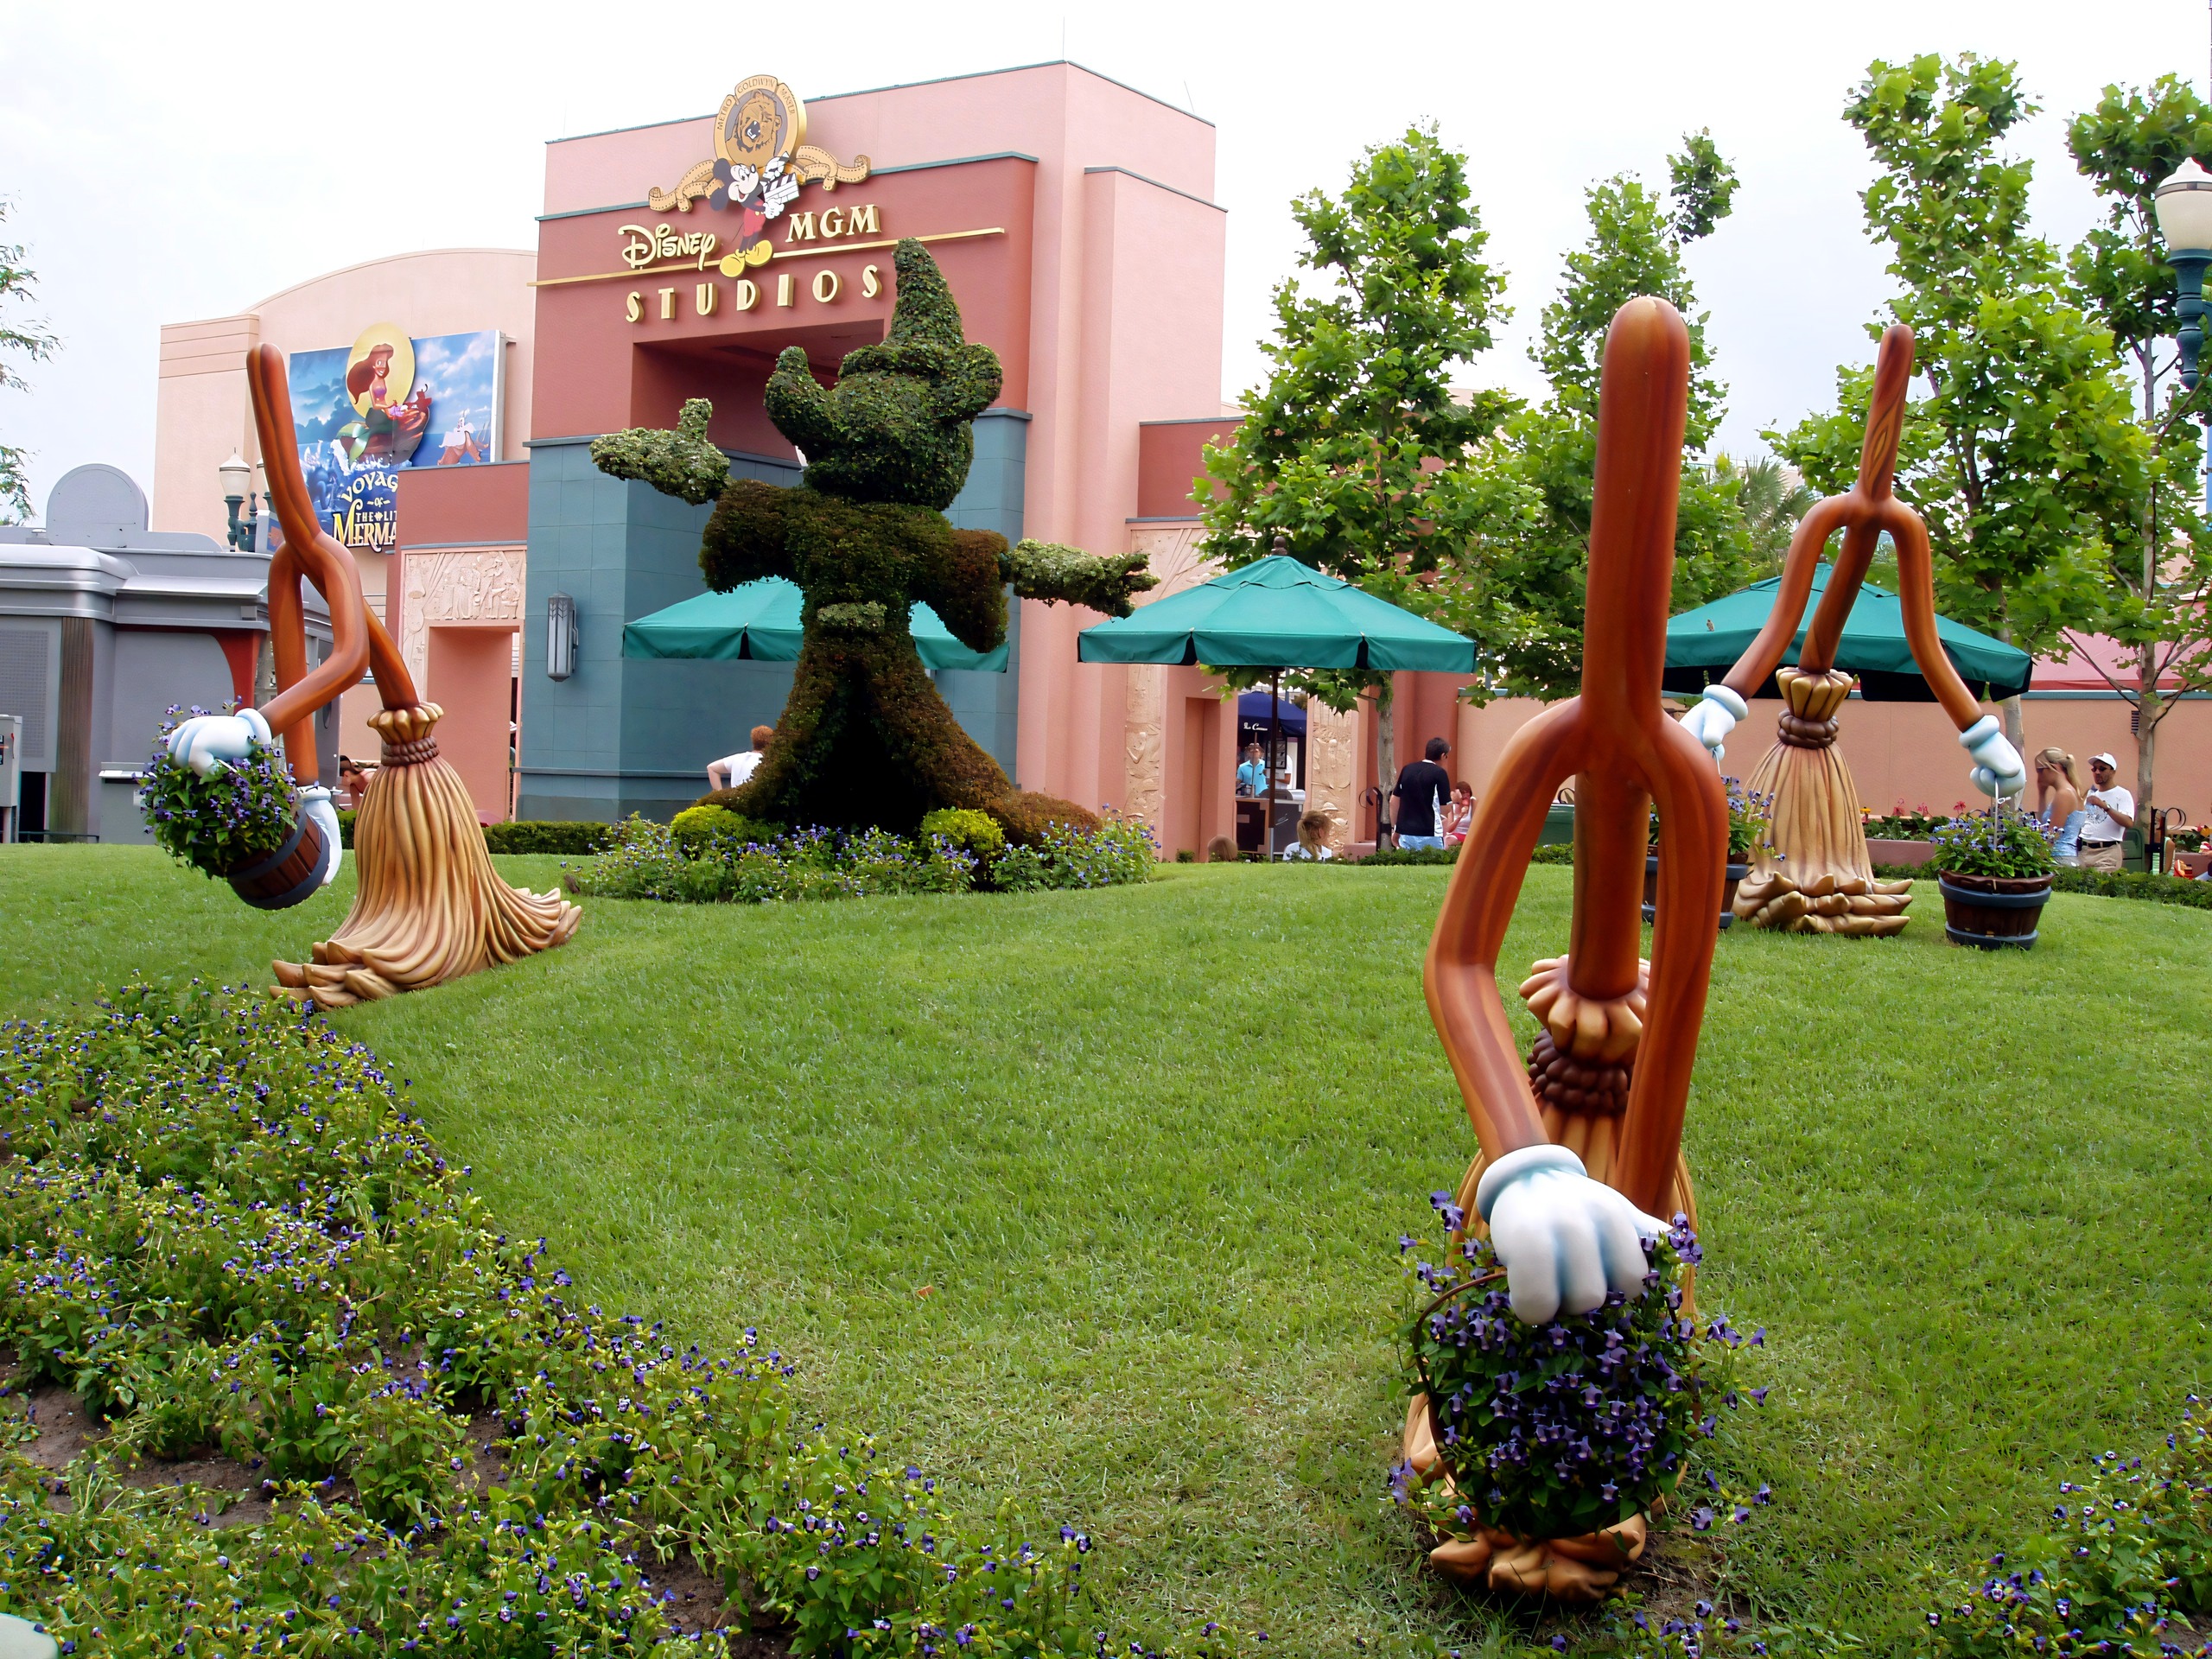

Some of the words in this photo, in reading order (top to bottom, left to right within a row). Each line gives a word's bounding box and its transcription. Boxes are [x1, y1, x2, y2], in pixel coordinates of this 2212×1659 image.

[716, 98, 733, 130] METRO
[737, 77, 776, 94] GOLDWYN
[785, 204, 881, 243] MGM
[626, 264, 883, 322] STUDIOS
[356, 512, 374, 523] THE
